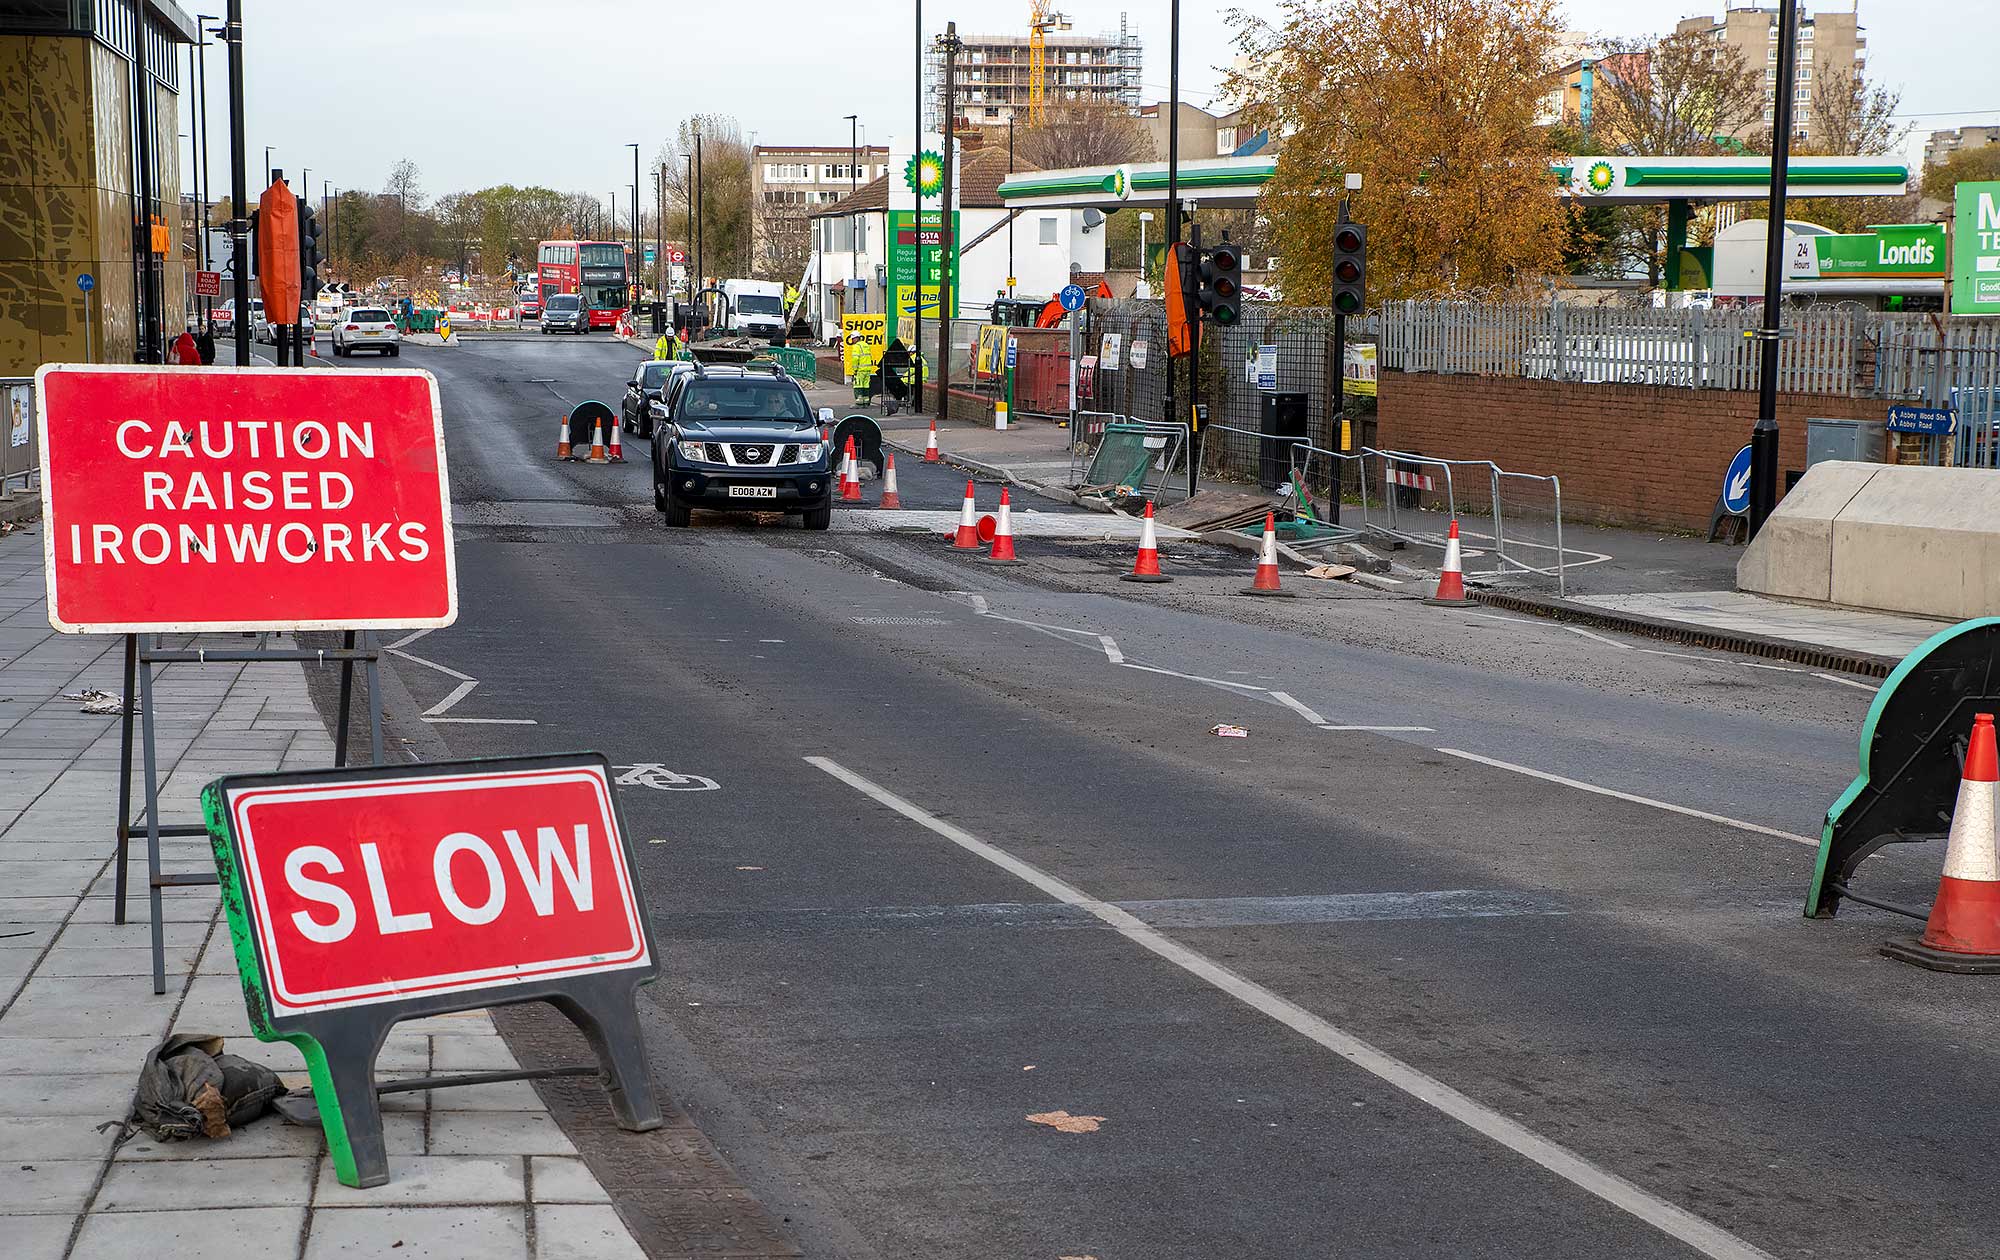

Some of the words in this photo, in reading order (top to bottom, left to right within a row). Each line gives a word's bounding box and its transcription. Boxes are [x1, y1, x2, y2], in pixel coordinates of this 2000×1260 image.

[1797, 242, 1808, 257] 24
[1878, 238, 1935, 265] Londis
[1793, 259, 1810, 270] Hours
[212, 311, 230, 319] AMP
[845, 320, 884, 331] SHOP
[1899, 411, 1917, 420] Abbey
[1919, 412, 1934, 420] Wood
[1899, 420, 1917, 429] Abbey
[1918, 421, 1933, 429] Road
[115, 419, 374, 459] CAUTION
[143, 471, 355, 511] RAISED
[70, 521, 430, 564] IRONWORKS
[284, 823, 595, 944] SLOW
